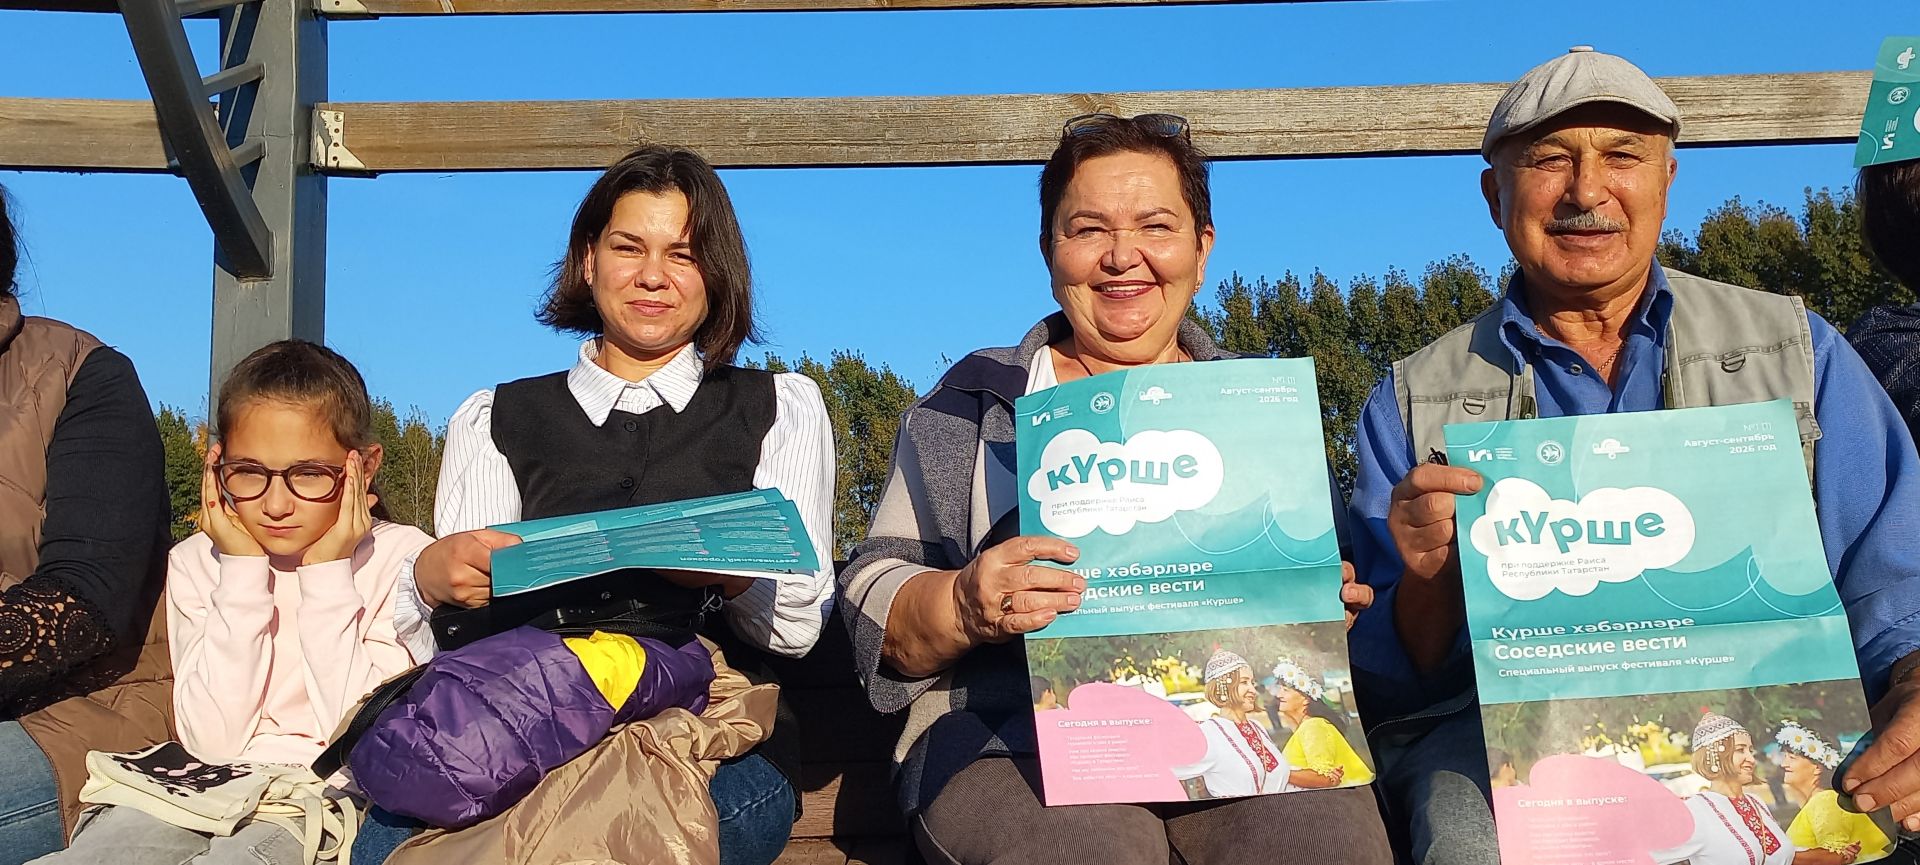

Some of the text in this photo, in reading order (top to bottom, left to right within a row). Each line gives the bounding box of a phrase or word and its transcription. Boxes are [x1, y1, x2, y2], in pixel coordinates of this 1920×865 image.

[1220, 386, 1298, 396] Август-сентябрь
[1684, 433, 1775, 448] Август-сентябрь
[1757, 443, 1777, 451] год
[1051, 502, 1068, 510] при
[1107, 561, 1213, 579] хәбәрләре
[1521, 559, 1575, 569] поддержке
[1577, 557, 1606, 565] Раиса
[1502, 566, 1610, 578] Республики Татарстан
[1080, 579, 1205, 601] дские вести
[1110, 603, 1146, 614] выпуск
[1147, 600, 1200, 611] фестиваля
[1572, 617, 1695, 634] хәбәрләре
[1494, 635, 1688, 660] Соседские вести
[1498, 663, 1575, 678] Специальный
[1577, 662, 1619, 675] выпуск
[1621, 659, 1682, 672] фестиваля
[1057, 719, 1099, 729] Сегодня
[1109, 718, 1153, 728] выпуске:
[1517, 795, 1628, 809] Сегодня в выпуске:
